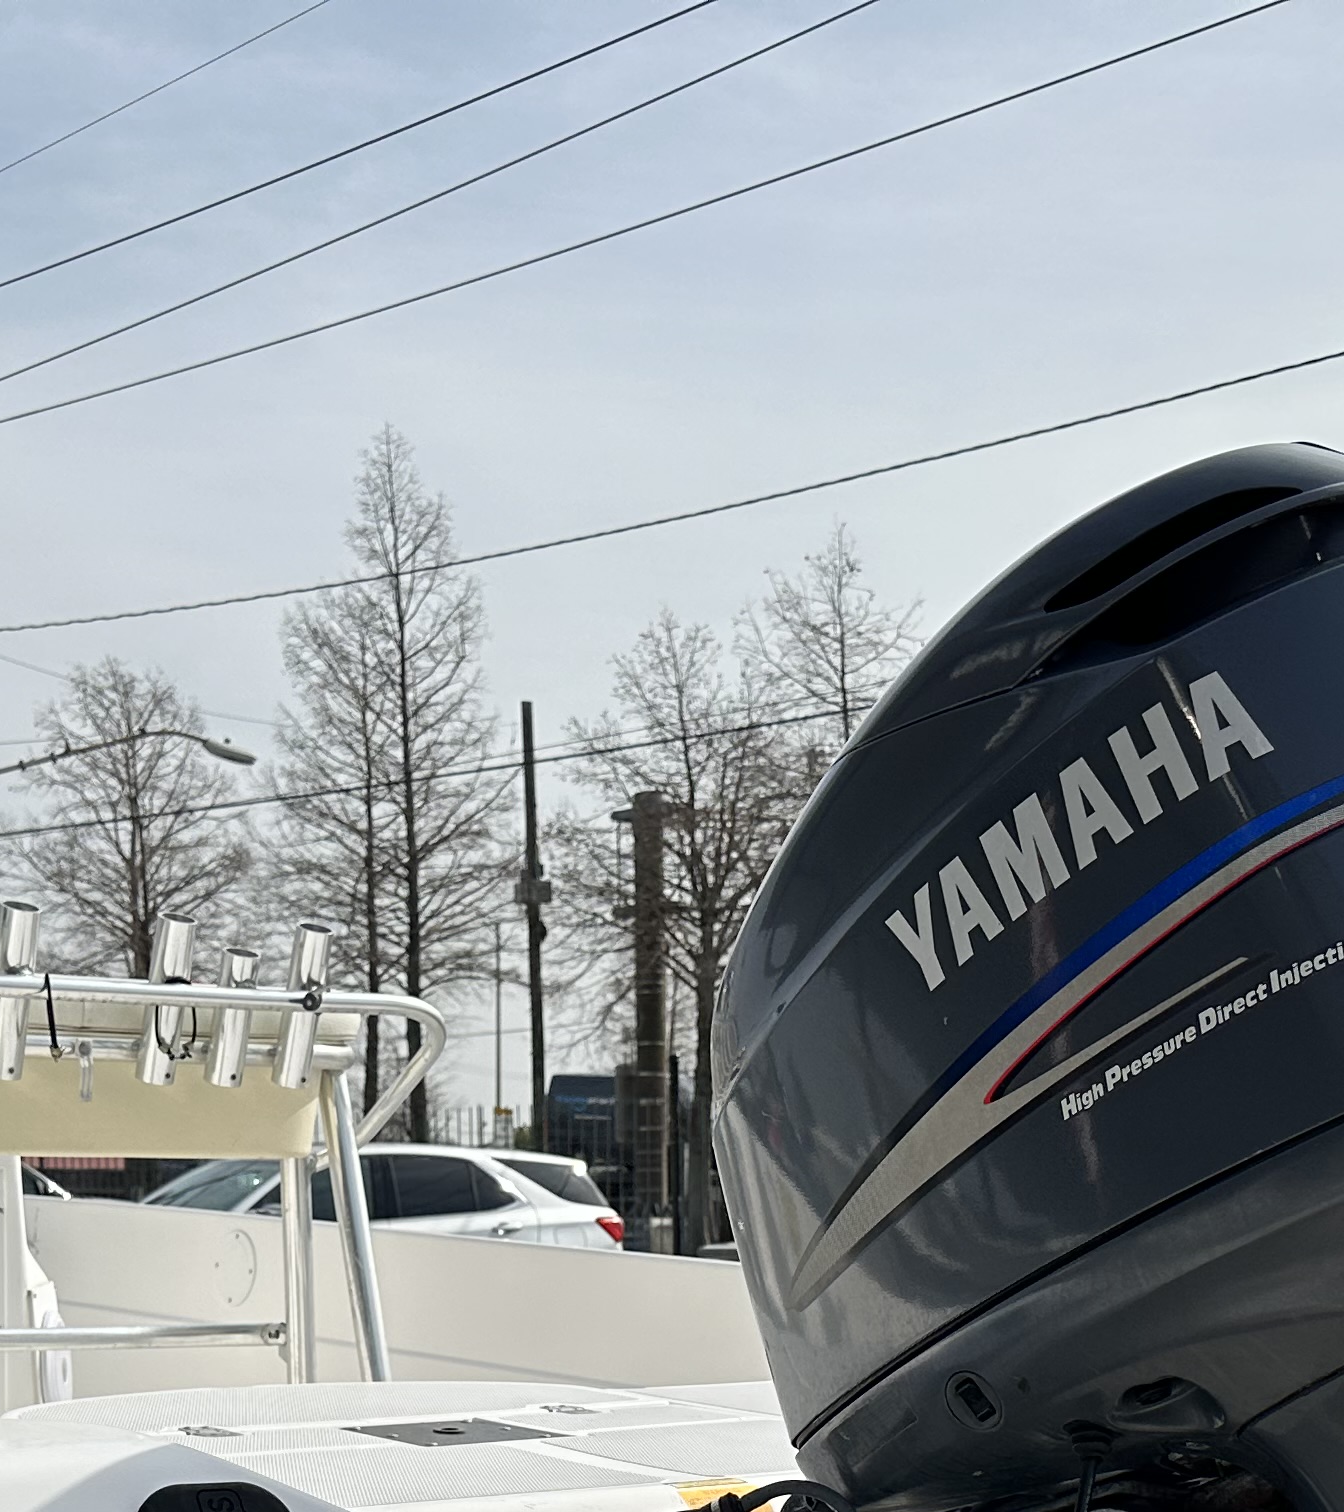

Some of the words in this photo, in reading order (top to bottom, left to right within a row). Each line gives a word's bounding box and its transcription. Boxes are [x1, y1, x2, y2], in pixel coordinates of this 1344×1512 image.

[884, 670, 1275, 992] YAMAHA
[1060, 1082, 1104, 1121] High
[1105, 1025, 1197, 1092] Pressure
[1198, 983, 1267, 1034] Direct
